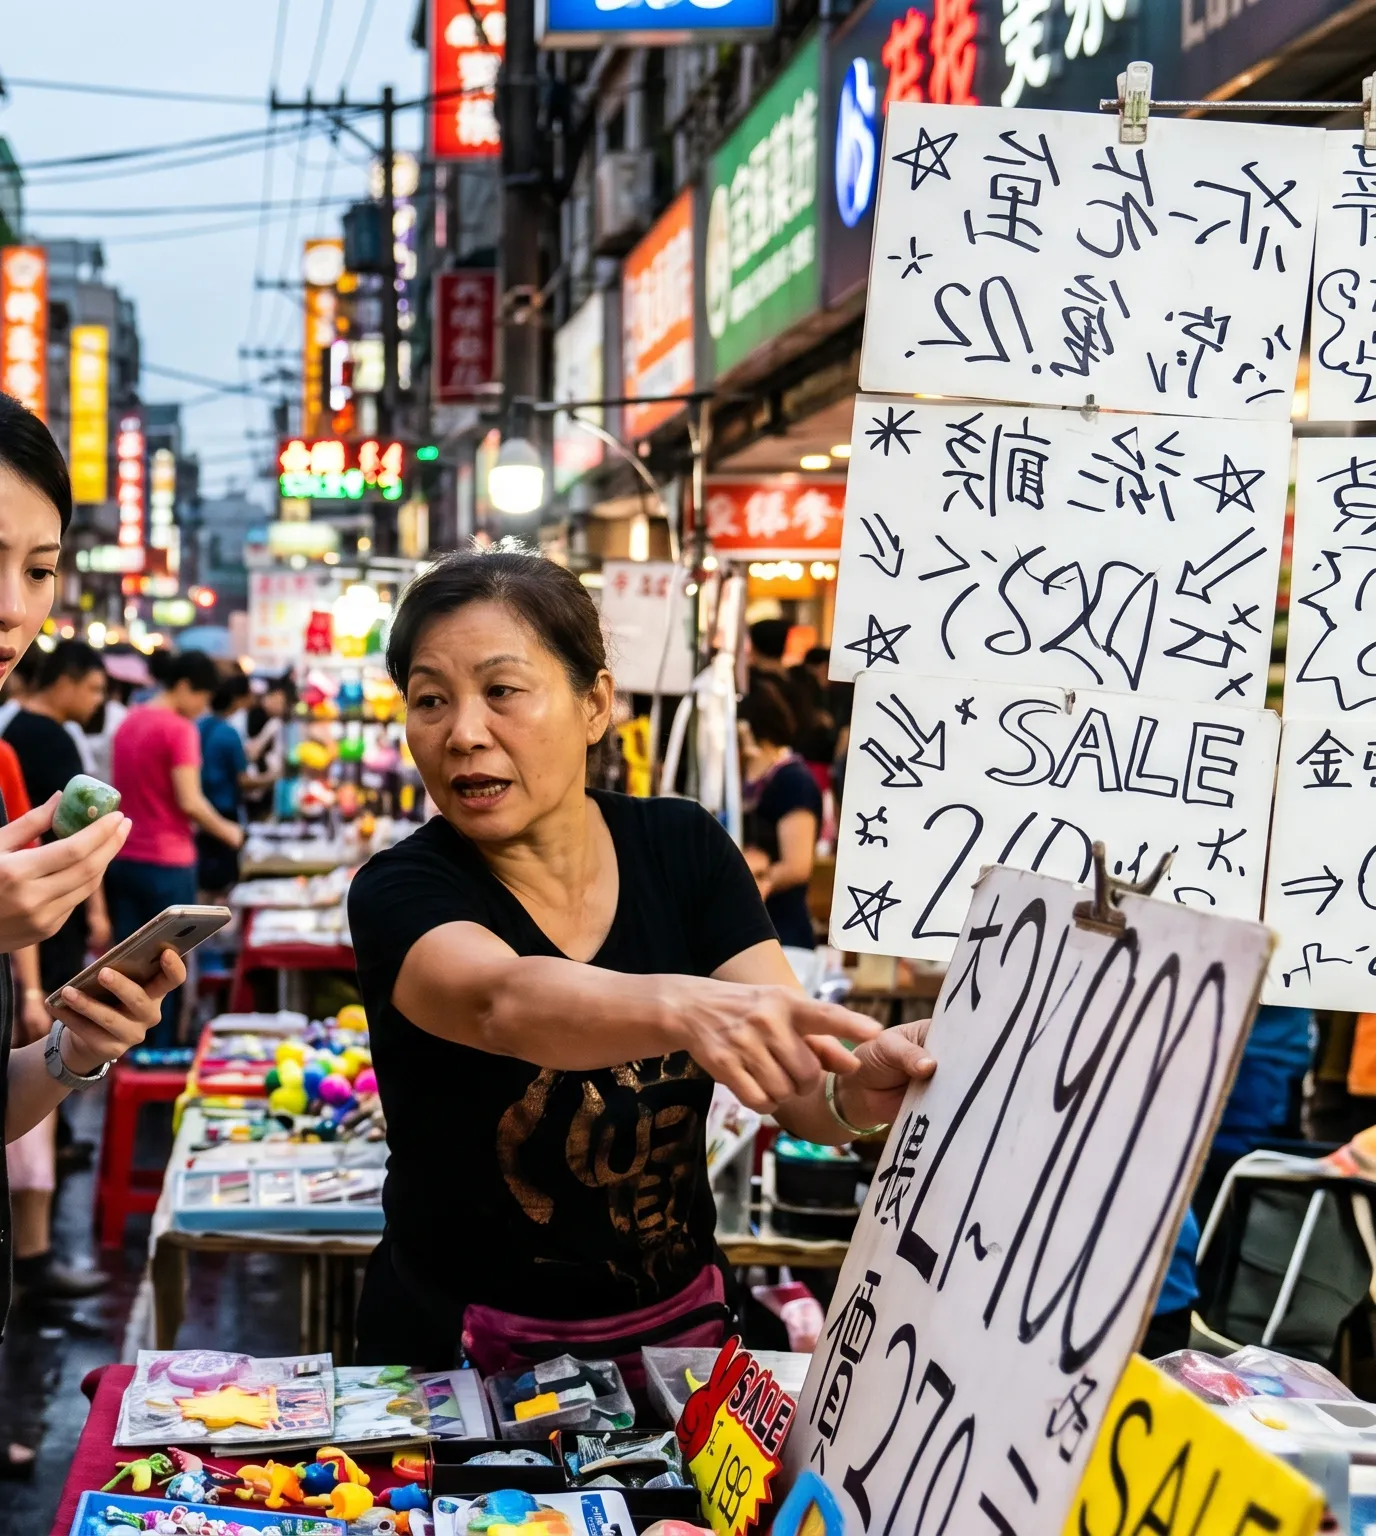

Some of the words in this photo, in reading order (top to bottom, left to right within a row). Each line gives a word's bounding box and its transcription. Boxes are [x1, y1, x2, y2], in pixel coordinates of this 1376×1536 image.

[985, 698, 1245, 809] SALE
[727, 1364, 794, 1456] SALE
[1079, 1397, 1282, 1536] SA
